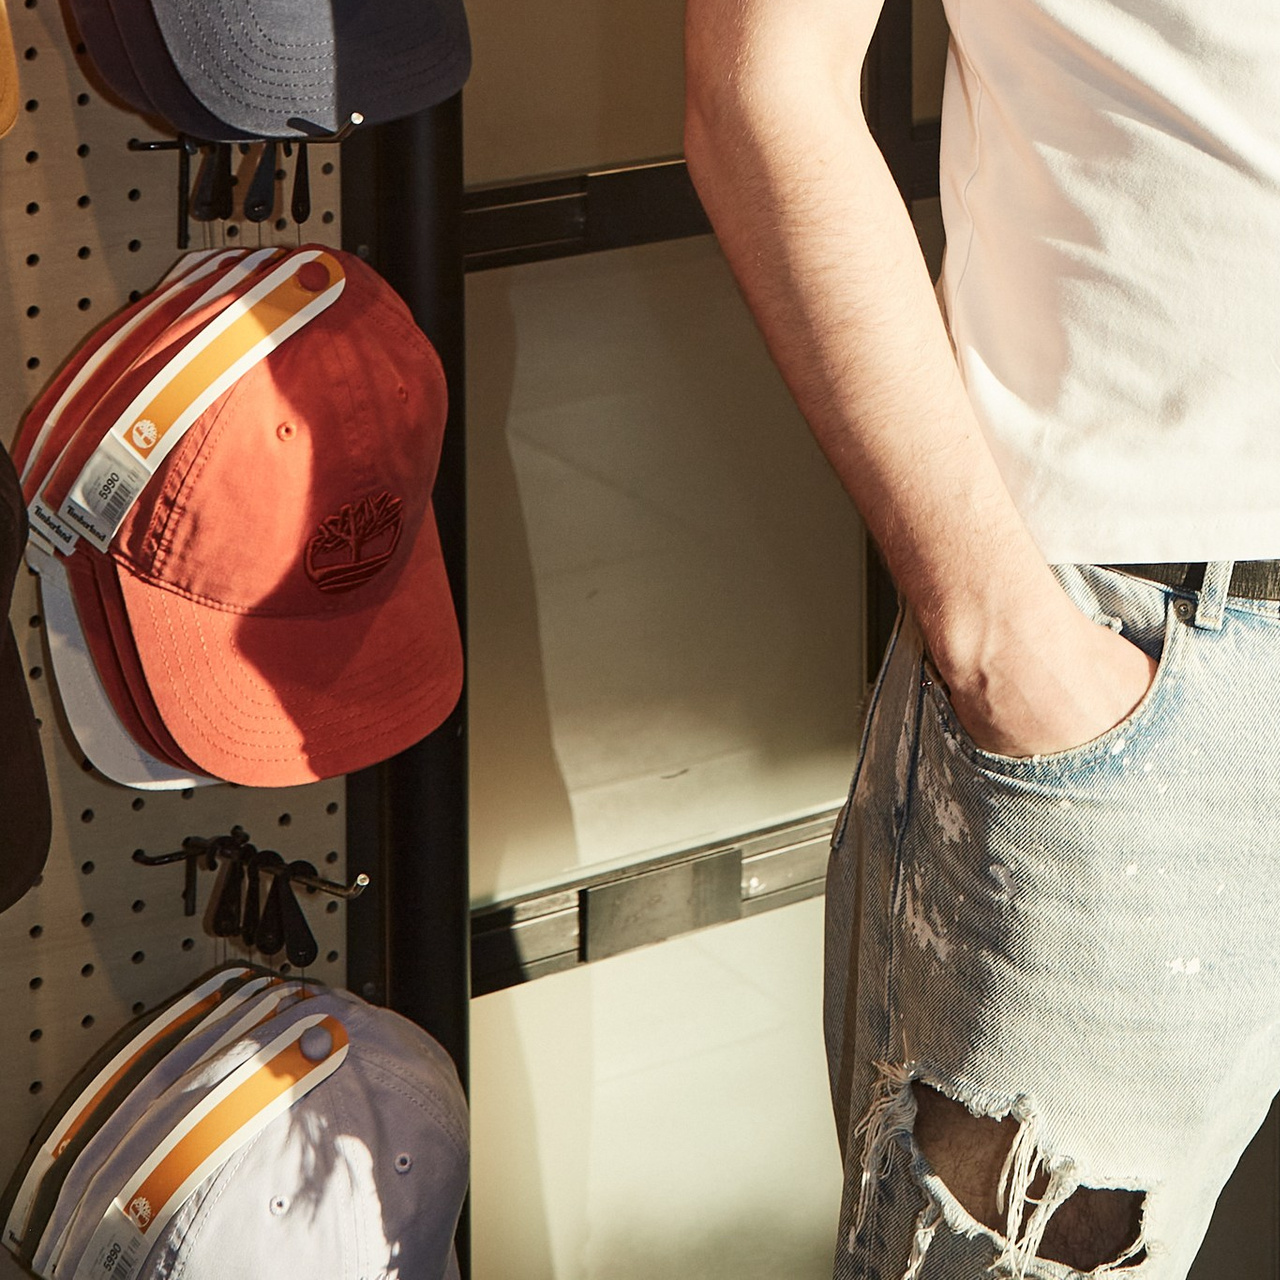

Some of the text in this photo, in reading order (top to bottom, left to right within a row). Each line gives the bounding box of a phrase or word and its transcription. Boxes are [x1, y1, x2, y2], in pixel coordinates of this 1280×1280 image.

[98, 472, 120, 500] 5990
[35, 505, 72, 544] Timberland
[67, 505, 107, 542] Timberland
[103, 1242, 122, 1272] 5990
